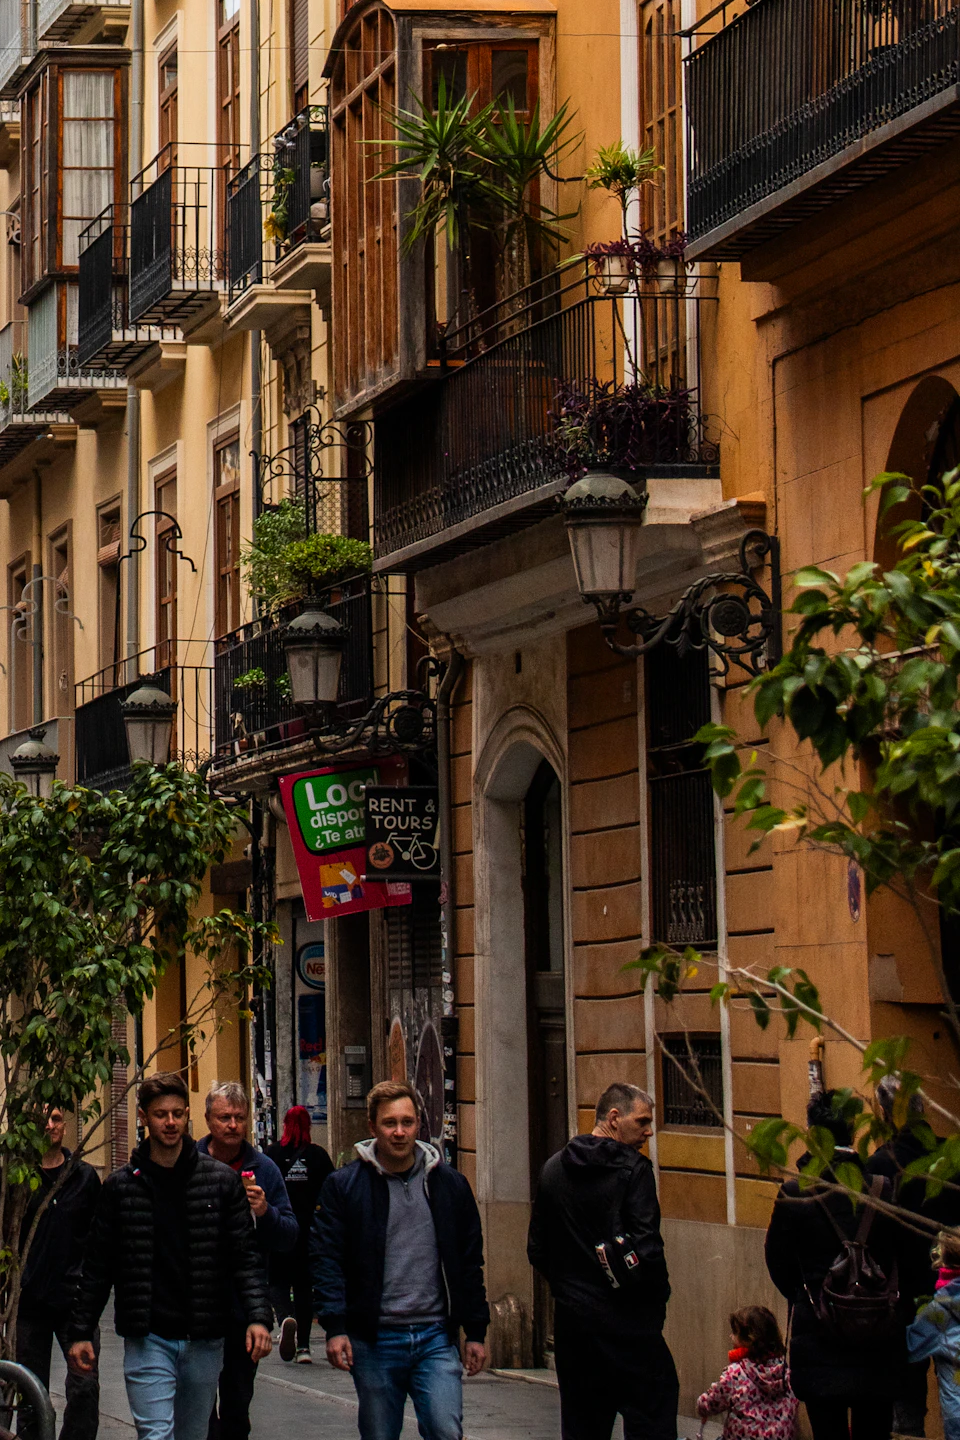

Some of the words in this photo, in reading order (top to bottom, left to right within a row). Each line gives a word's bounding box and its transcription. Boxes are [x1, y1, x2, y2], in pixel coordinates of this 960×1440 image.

[368, 797, 416, 813] RENT
[424, 798, 436, 813] &
[371, 815, 433, 830] TOURS
[315, 829, 341, 849] ¿Te
